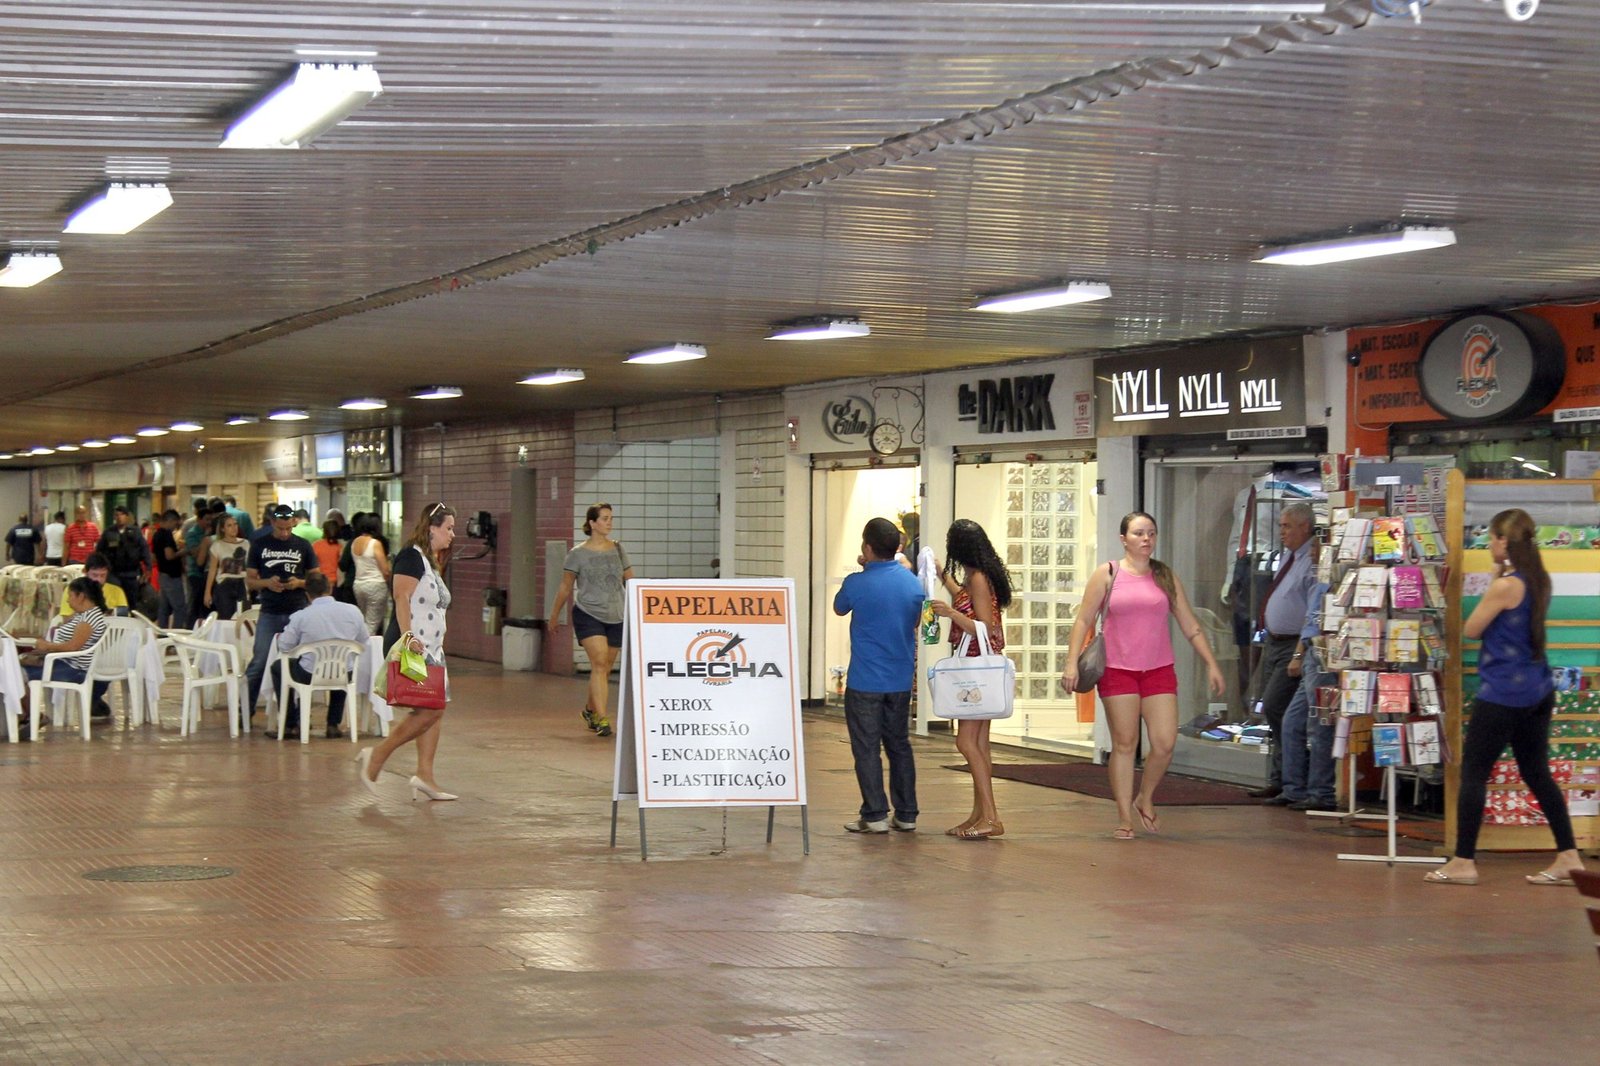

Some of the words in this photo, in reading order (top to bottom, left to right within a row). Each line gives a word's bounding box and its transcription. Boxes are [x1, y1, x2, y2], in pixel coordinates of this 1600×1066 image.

[1382, 331, 1420, 350] ESCOLAR
[1577, 345, 1595, 364] QUE
[1112, 368, 1169, 414] NYLL
[1179, 372, 1229, 411] NYLL
[1240, 378, 1282, 408] NYLL
[1456, 377, 1499, 392] FLECHA
[978, 373, 1056, 434] DARK
[284, 563, 297, 573] 87
[645, 596, 783, 617] PAPELARIA
[696, 628, 734, 637] PAPELARIA
[647, 661, 784, 678] FLECHA
[702, 679, 733, 687] LIVRARIA
[660, 698, 713, 711] XEROX
[661, 721, 750, 736] IMPRESSÃO
[662, 746, 790, 765] ENCADERNAÇÃO
[663, 771, 786, 790] PLASTIFICAÇÃO
